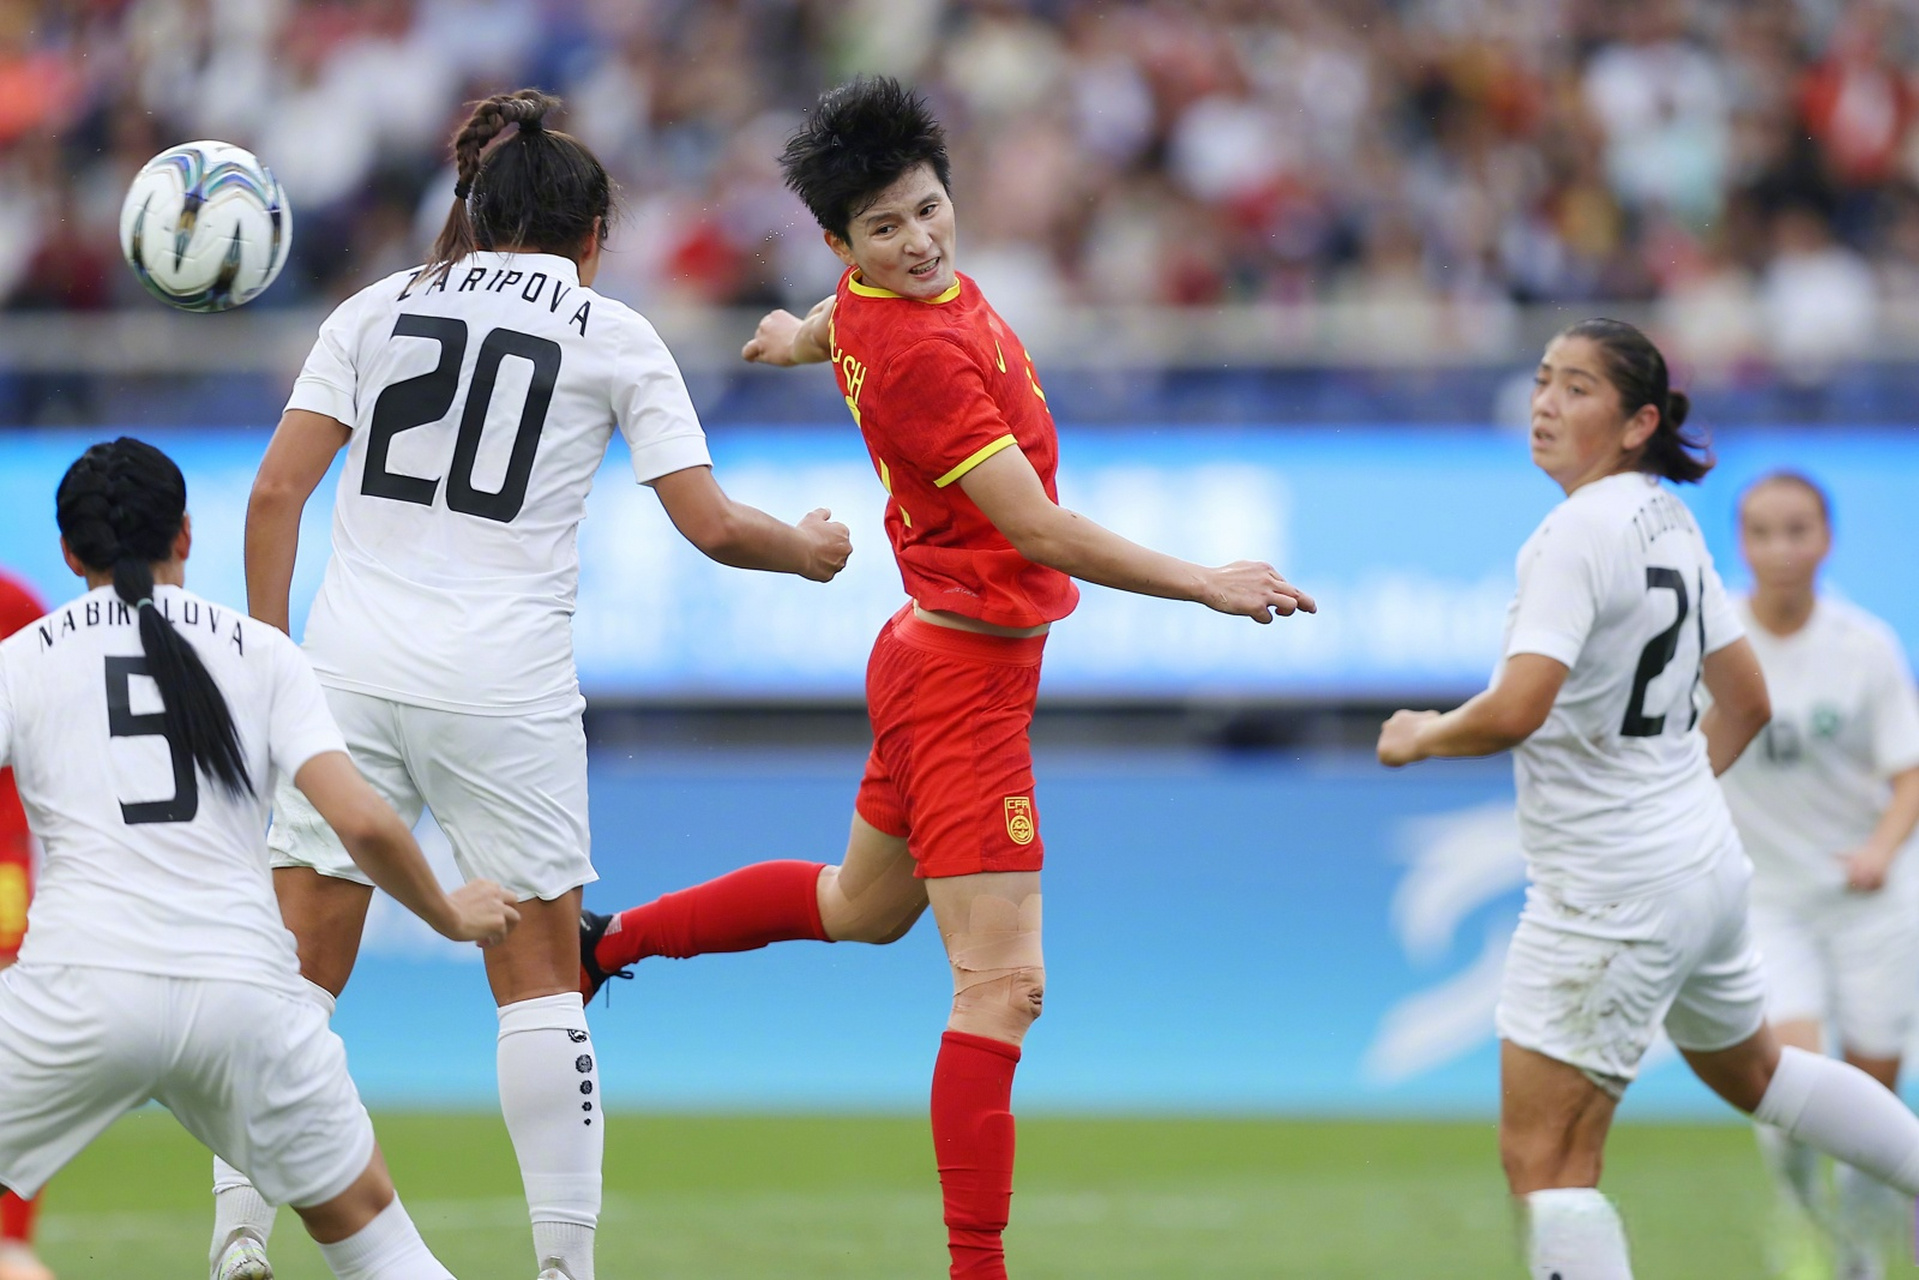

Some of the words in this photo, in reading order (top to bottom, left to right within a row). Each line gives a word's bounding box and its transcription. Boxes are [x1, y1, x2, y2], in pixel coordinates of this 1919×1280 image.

[396, 266, 592, 338] ZARIPOVA
[360, 312, 562, 523] 20
[38, 598, 244, 657] NABIKLOVA
[104, 655, 199, 825] 5
